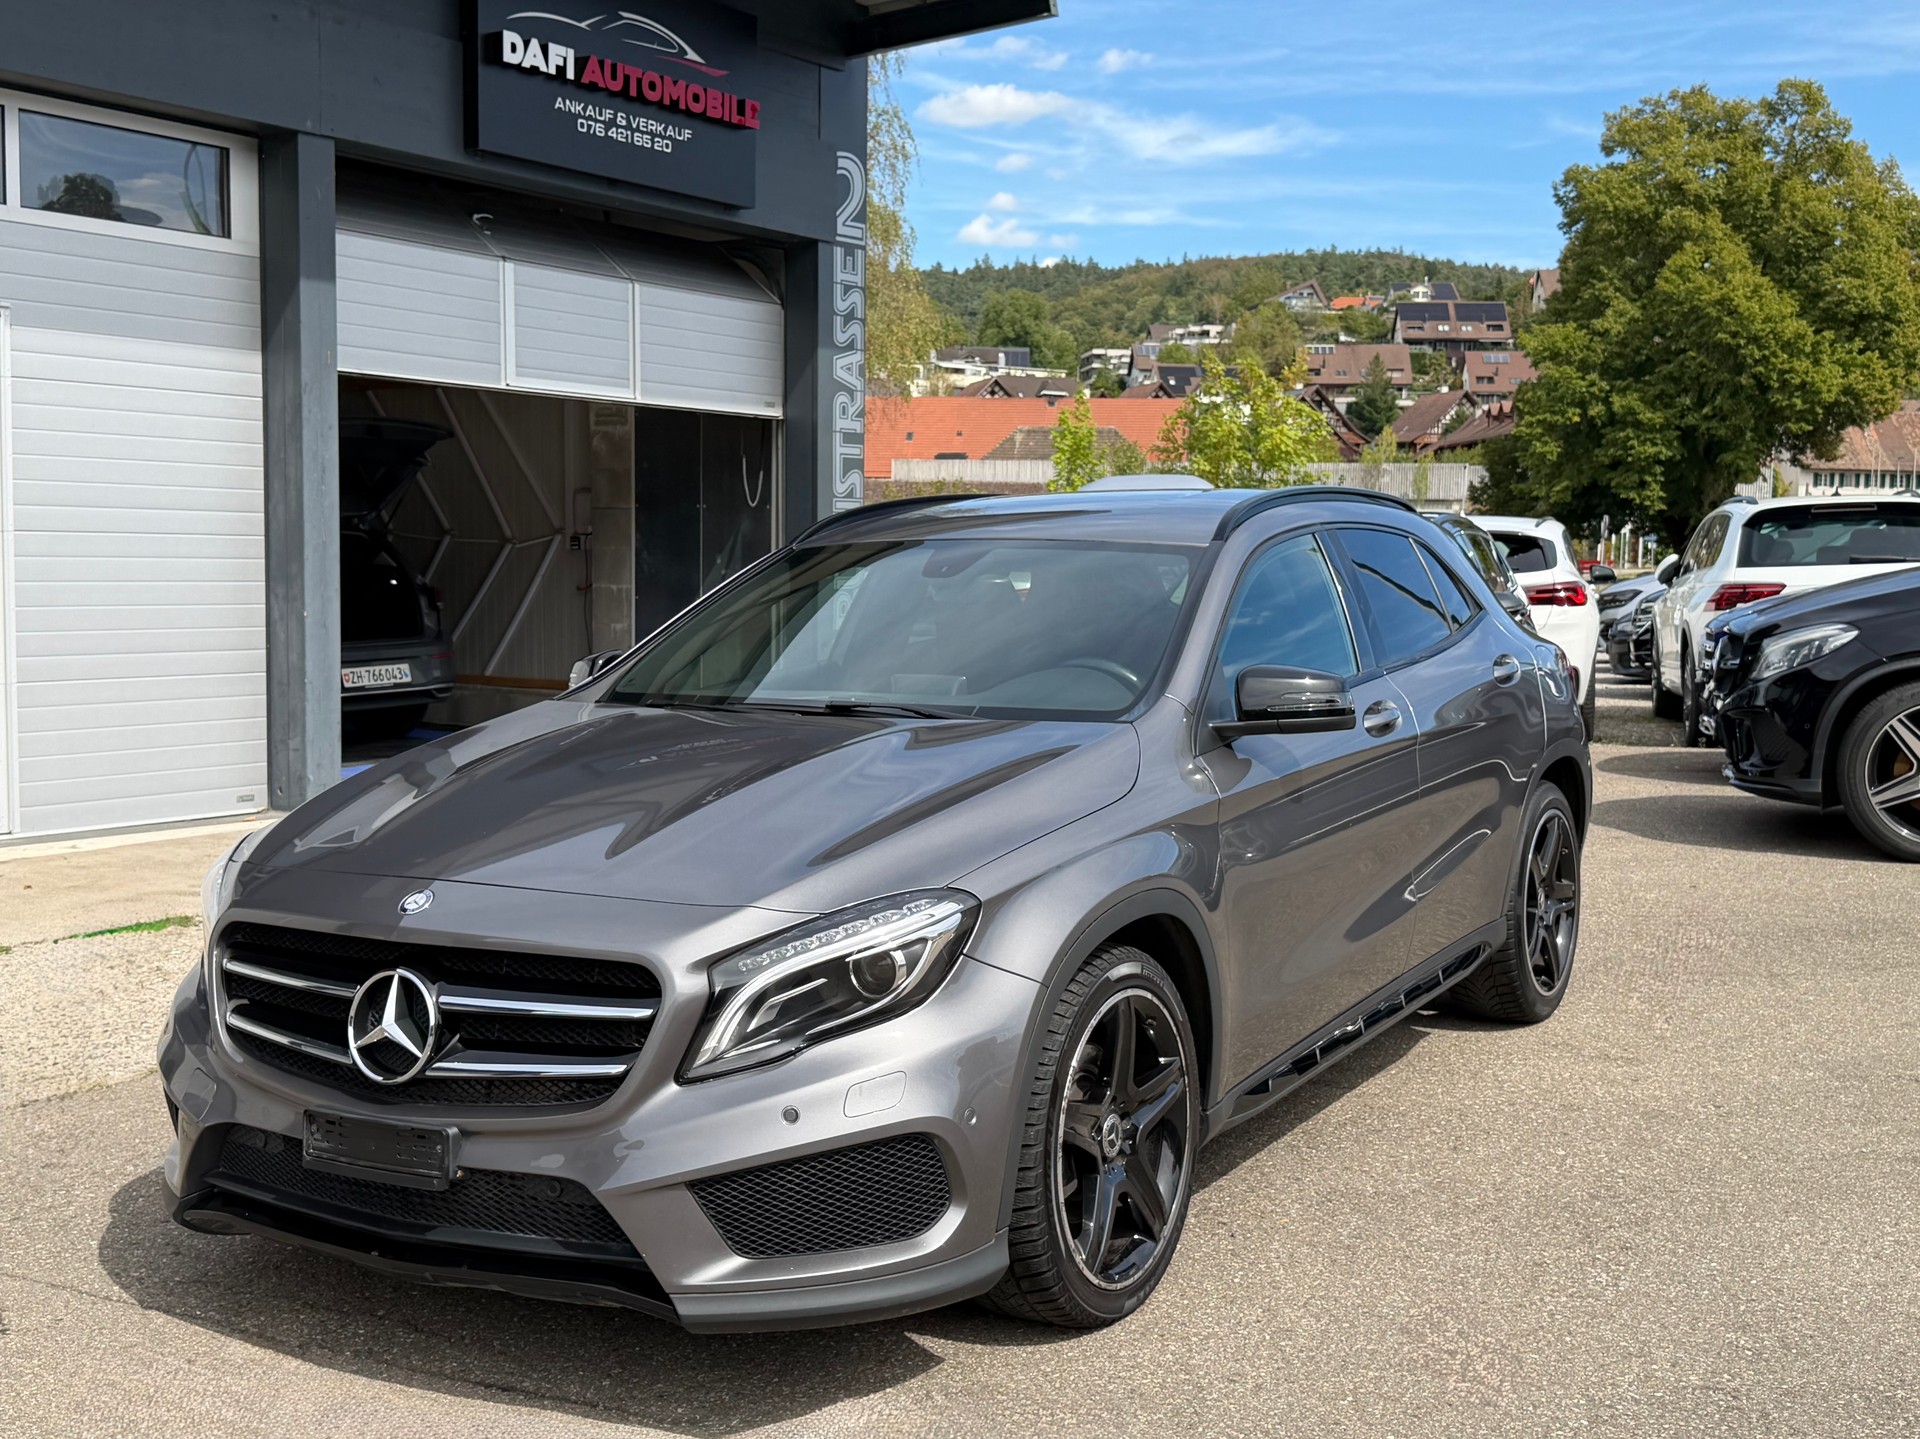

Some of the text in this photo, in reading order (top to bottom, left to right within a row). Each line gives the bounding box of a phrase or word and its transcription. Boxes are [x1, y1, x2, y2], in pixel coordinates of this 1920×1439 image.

[503, 29, 760, 130] DAFI AUTOMOBILE
[554, 96, 693, 141] ANKAUF & VERKAUF
[577, 118, 672, 153] 076 421 65 20
